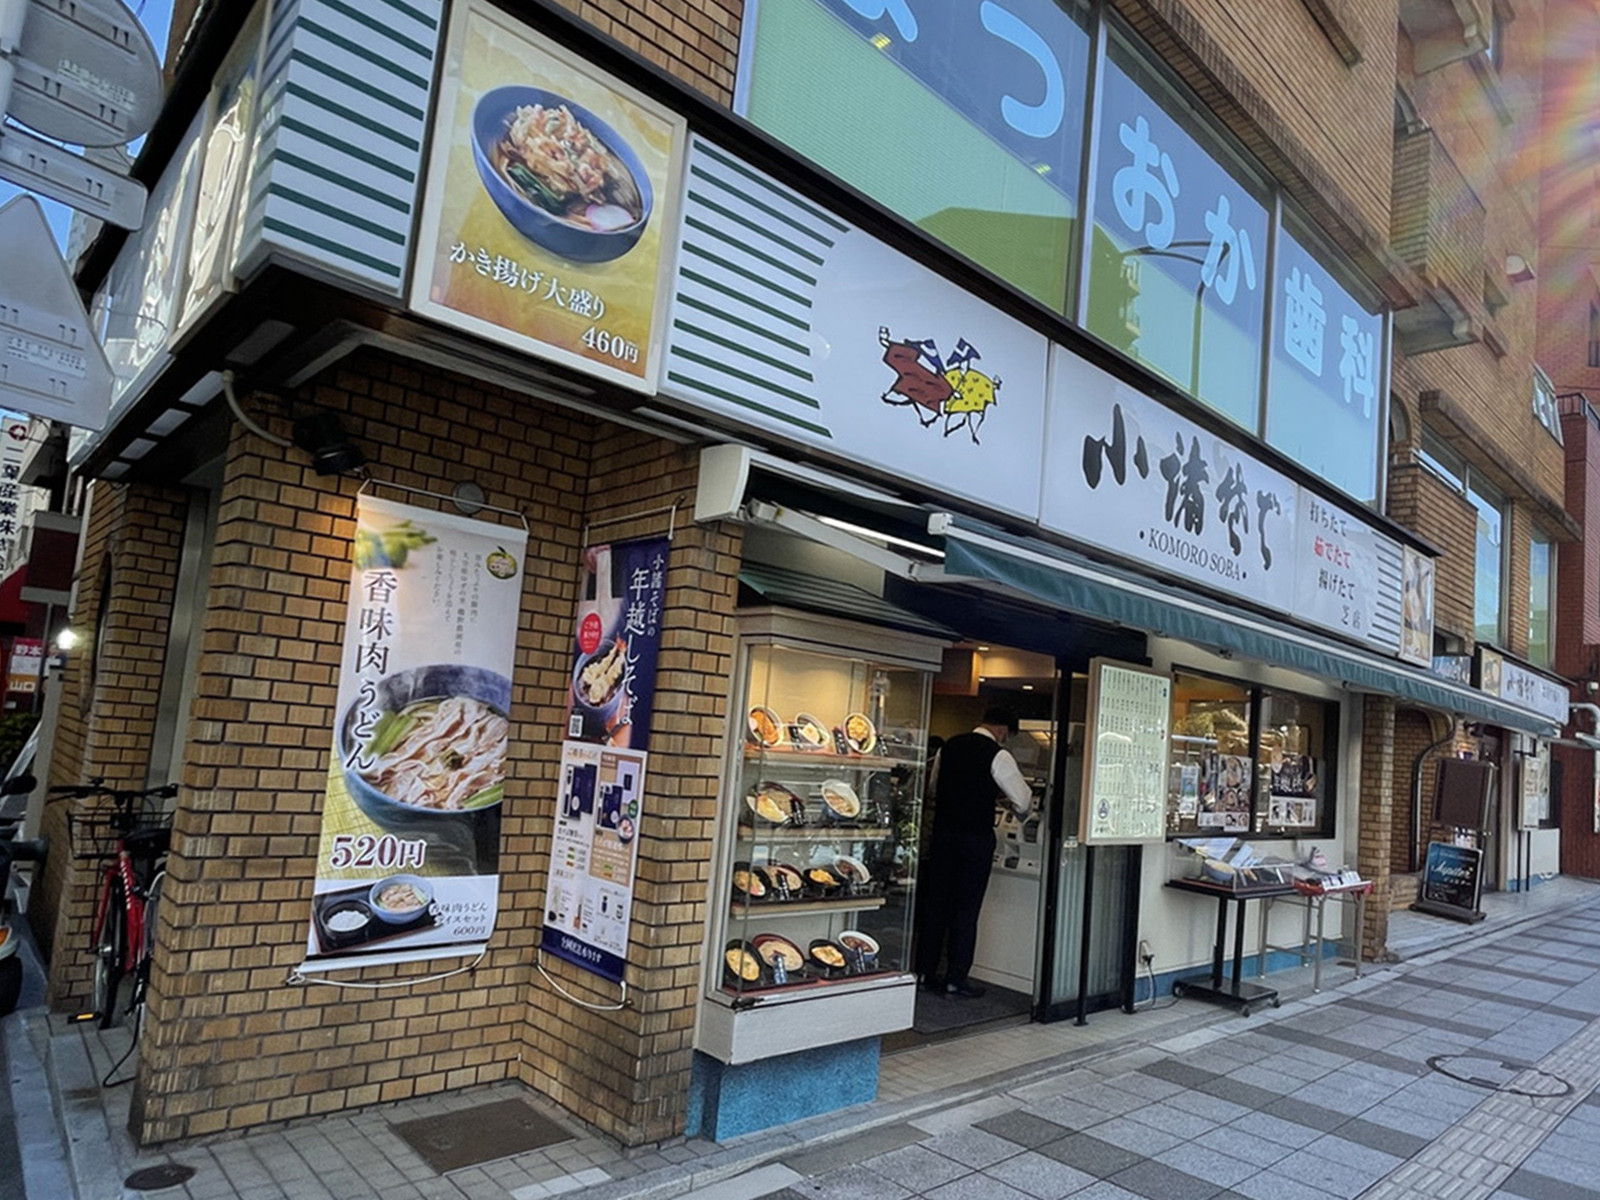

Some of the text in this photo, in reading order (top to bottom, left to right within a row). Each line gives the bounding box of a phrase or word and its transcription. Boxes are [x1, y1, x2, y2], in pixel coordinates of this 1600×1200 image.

[450, 242, 606, 320] かき揚げ大盛り
[582, 326, 639, 364] 460円
[1310, 502, 1347, 537] 打ちたて
[1148, 527, 1241, 581] KOMORO SOBA
[618, 567, 650, 726] 年越しそば
[345, 571, 398, 770] 香味肉うどん
[332, 836, 425, 867] 520円
[453, 926, 486, 936] 600円
